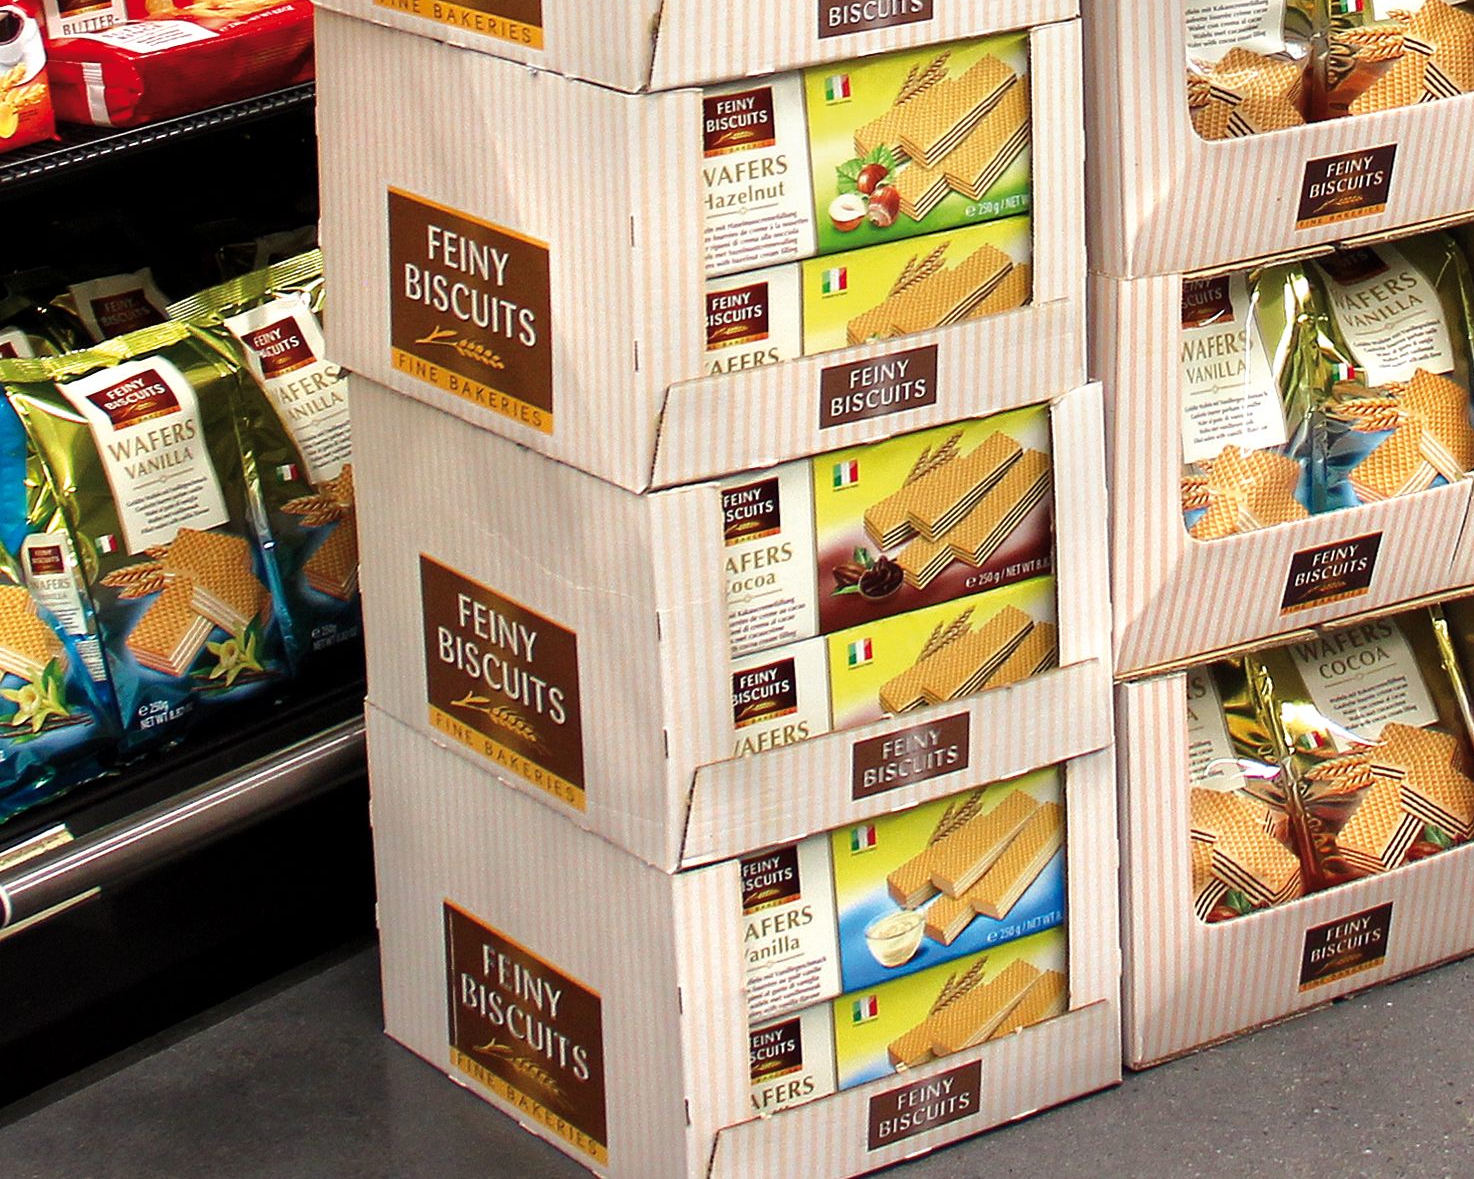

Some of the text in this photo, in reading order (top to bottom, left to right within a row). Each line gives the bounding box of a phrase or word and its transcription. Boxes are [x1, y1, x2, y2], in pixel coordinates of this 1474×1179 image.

[434, 3, 532, 44] BAKERIES
[1309, 171, 1384, 198] BISCUITS
[427, 224, 509, 286] FEINY
[405, 263, 537, 347] BISCUITS
[1334, 272, 1417, 310] WAFERS
[1343, 295, 1424, 329] VANILLA
[1181, 331, 1254, 363] WAFERS
[106, 378, 144, 400] FEINY
[399, 355, 542, 427] FINE BAKERIES
[849, 359, 910, 389] FEINY
[1186, 361, 1248, 385] VANILLA
[830, 378, 927, 417] BISCUITS
[108, 419, 195, 462] WAFERS
[124, 446, 193, 479] VANILLA
[726, 500, 774, 522] SCUITS
[725, 543, 793, 574] AFERS
[1295, 557, 1368, 587] BISCUITS
[727, 573, 776, 597] ocoa
[458, 593, 537, 662] FEINY
[1296, 620, 1392, 664] WAFERS
[438, 625, 566, 725] BISCUITS
[1319, 647, 1390, 678] COCOA
[436, 713, 576, 803] FINE BAKERIES
[863, 746, 958, 787] BISCUITS
[745, 905, 813, 942] AFERS
[1326, 917, 1371, 941] FEINY
[746, 935, 800, 965] anilla
[1310, 928, 1381, 962] BISCUITS
[483, 944, 562, 1019] FEINY
[461, 973, 589, 1081] BISCUITS
[456, 1051, 597, 1156] FINE BAKERIES
[896, 1077, 955, 1110] FEINY
[878, 1091, 970, 1138] BISCUITS
